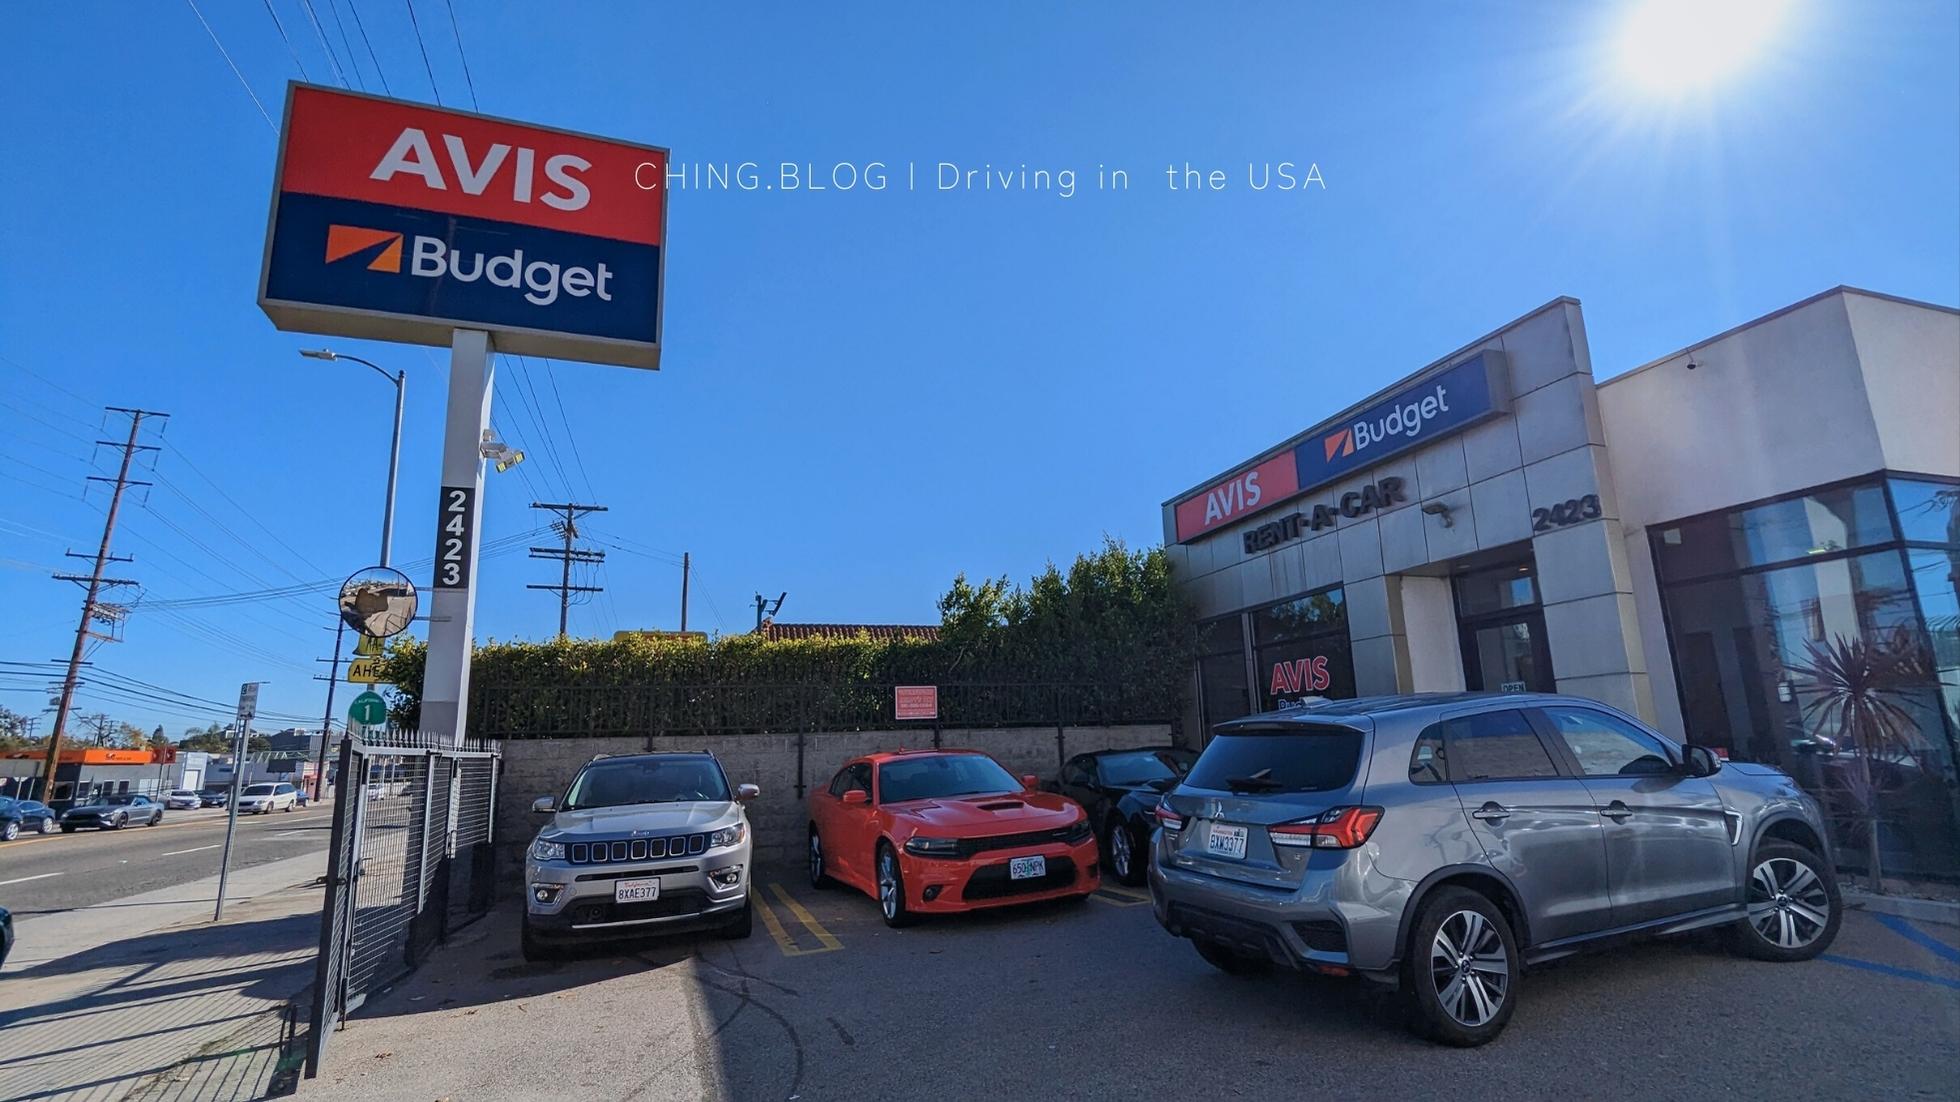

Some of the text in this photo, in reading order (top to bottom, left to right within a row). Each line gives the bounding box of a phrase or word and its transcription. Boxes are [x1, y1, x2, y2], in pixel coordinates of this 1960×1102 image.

[369, 127, 593, 212] AVIS
[411, 235, 613, 306] Budget
[1204, 385, 1449, 526] AVIS Budget
[442, 490, 466, 586] 2423
[1243, 476, 1406, 554] RENT-A-CAR
[1532, 493, 1602, 532] 2423
[352, 664, 381, 678] AHE
[1270, 655, 1330, 695] AVIS
[364, 704, 371, 721] 1
[618, 886, 657, 900] 8XAE377
